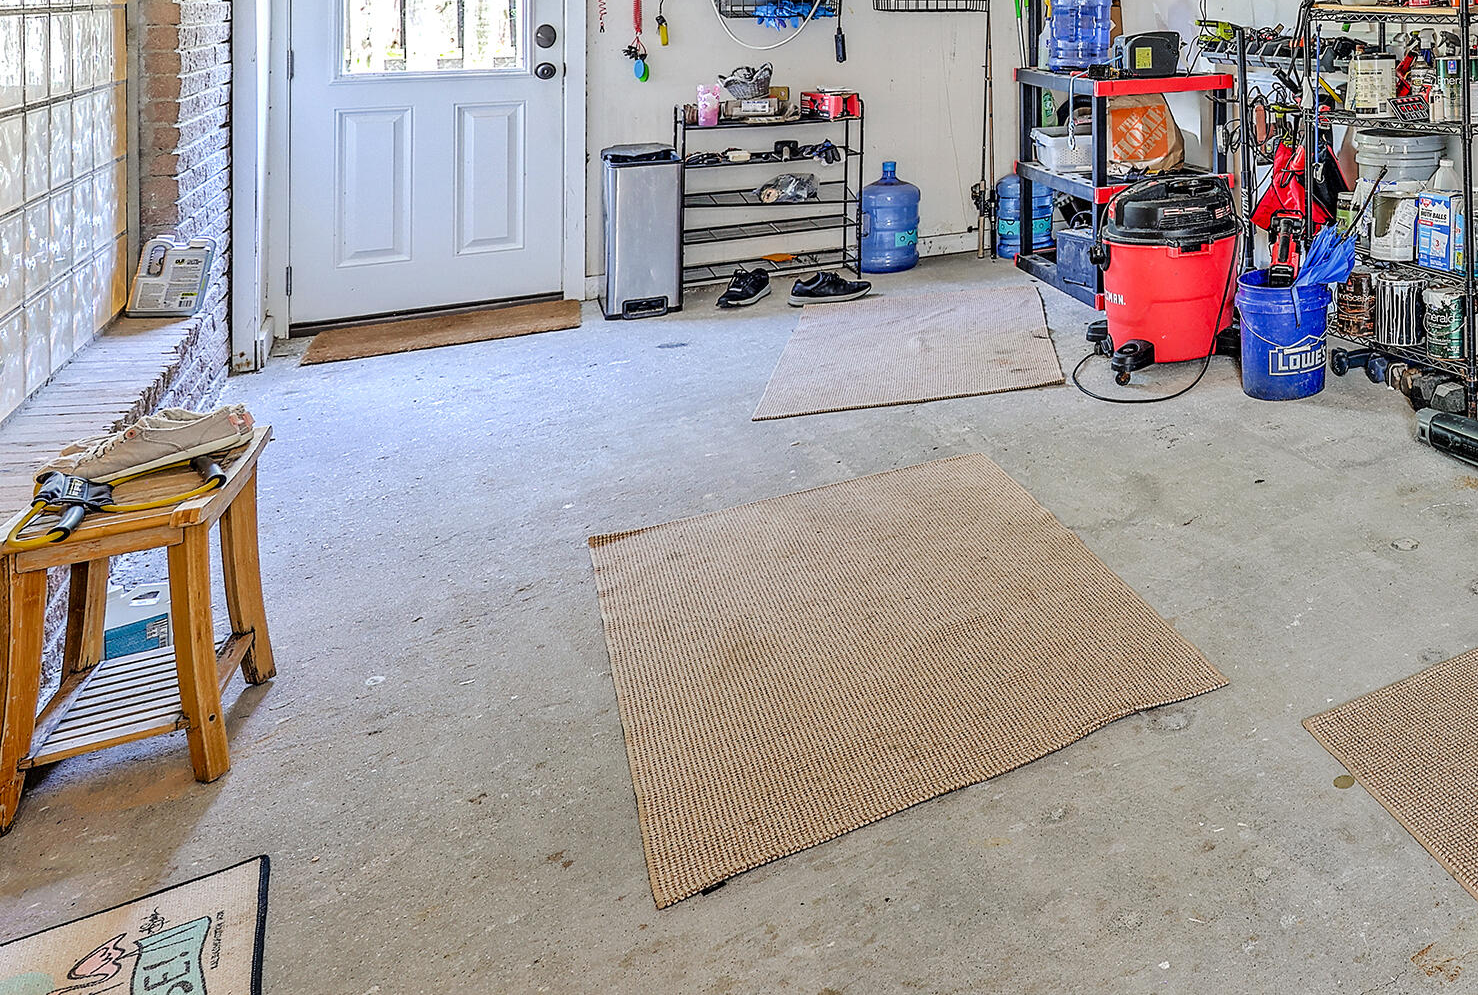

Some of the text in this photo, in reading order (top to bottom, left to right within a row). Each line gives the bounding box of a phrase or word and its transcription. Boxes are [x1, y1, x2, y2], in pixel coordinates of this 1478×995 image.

[1437, 75, 1475, 86] Emerad
[1113, 106, 1164, 160] HOME
[1117, 112, 1140, 133] THE
[1135, 123, 1168, 160] DEPOT
[1432, 212, 1447, 220] BALLS
[1435, 239, 1440, 247] 3
[1277, 344, 1327, 372] LOWE'S
